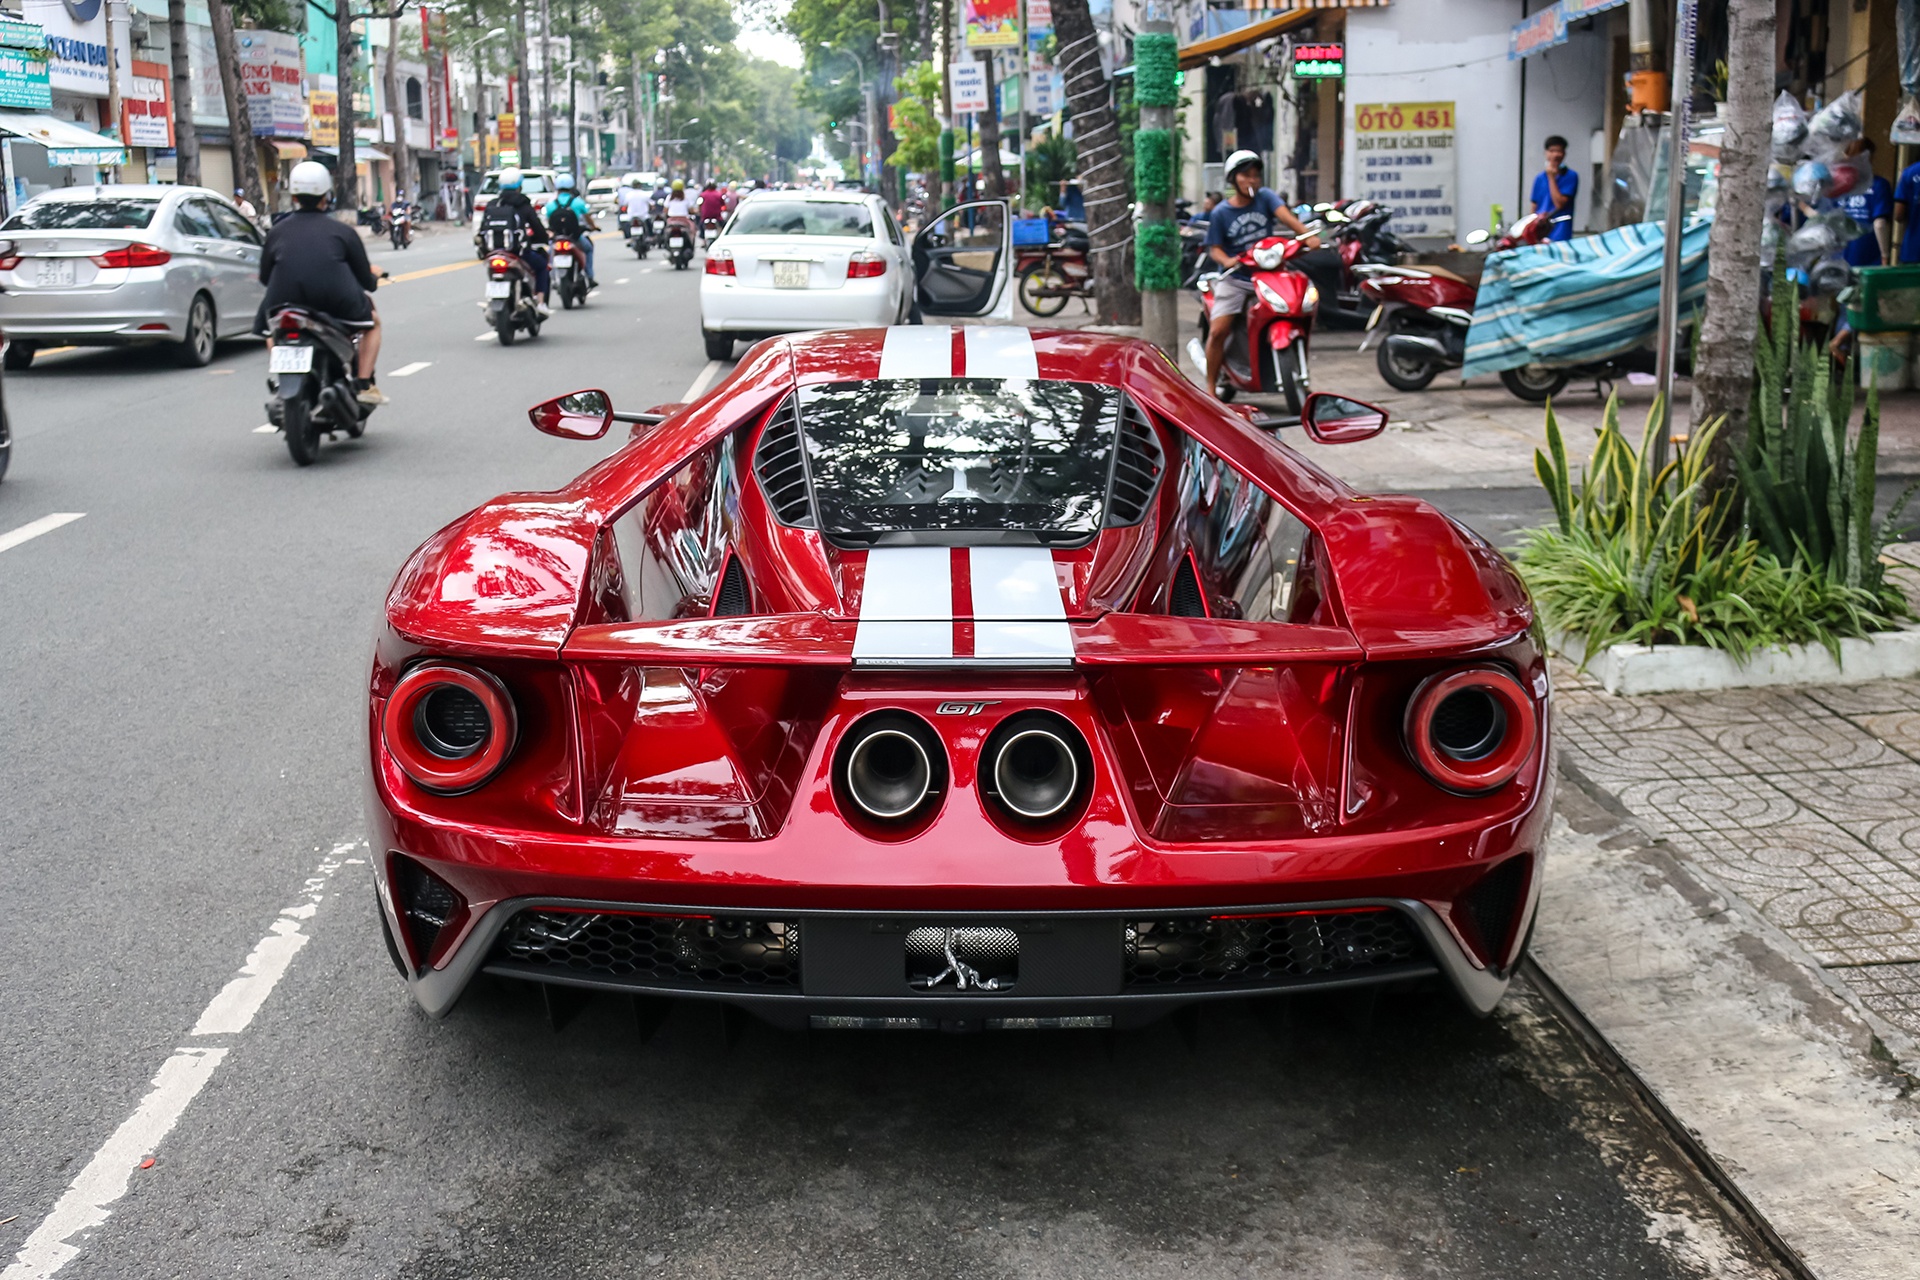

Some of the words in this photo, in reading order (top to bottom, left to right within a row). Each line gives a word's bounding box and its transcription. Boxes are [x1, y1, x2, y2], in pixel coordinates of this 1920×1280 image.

[1358, 106, 1404, 130] ÔTÔ
[1413, 110, 1453, 129] 451
[935, 700, 1002, 716] GT
